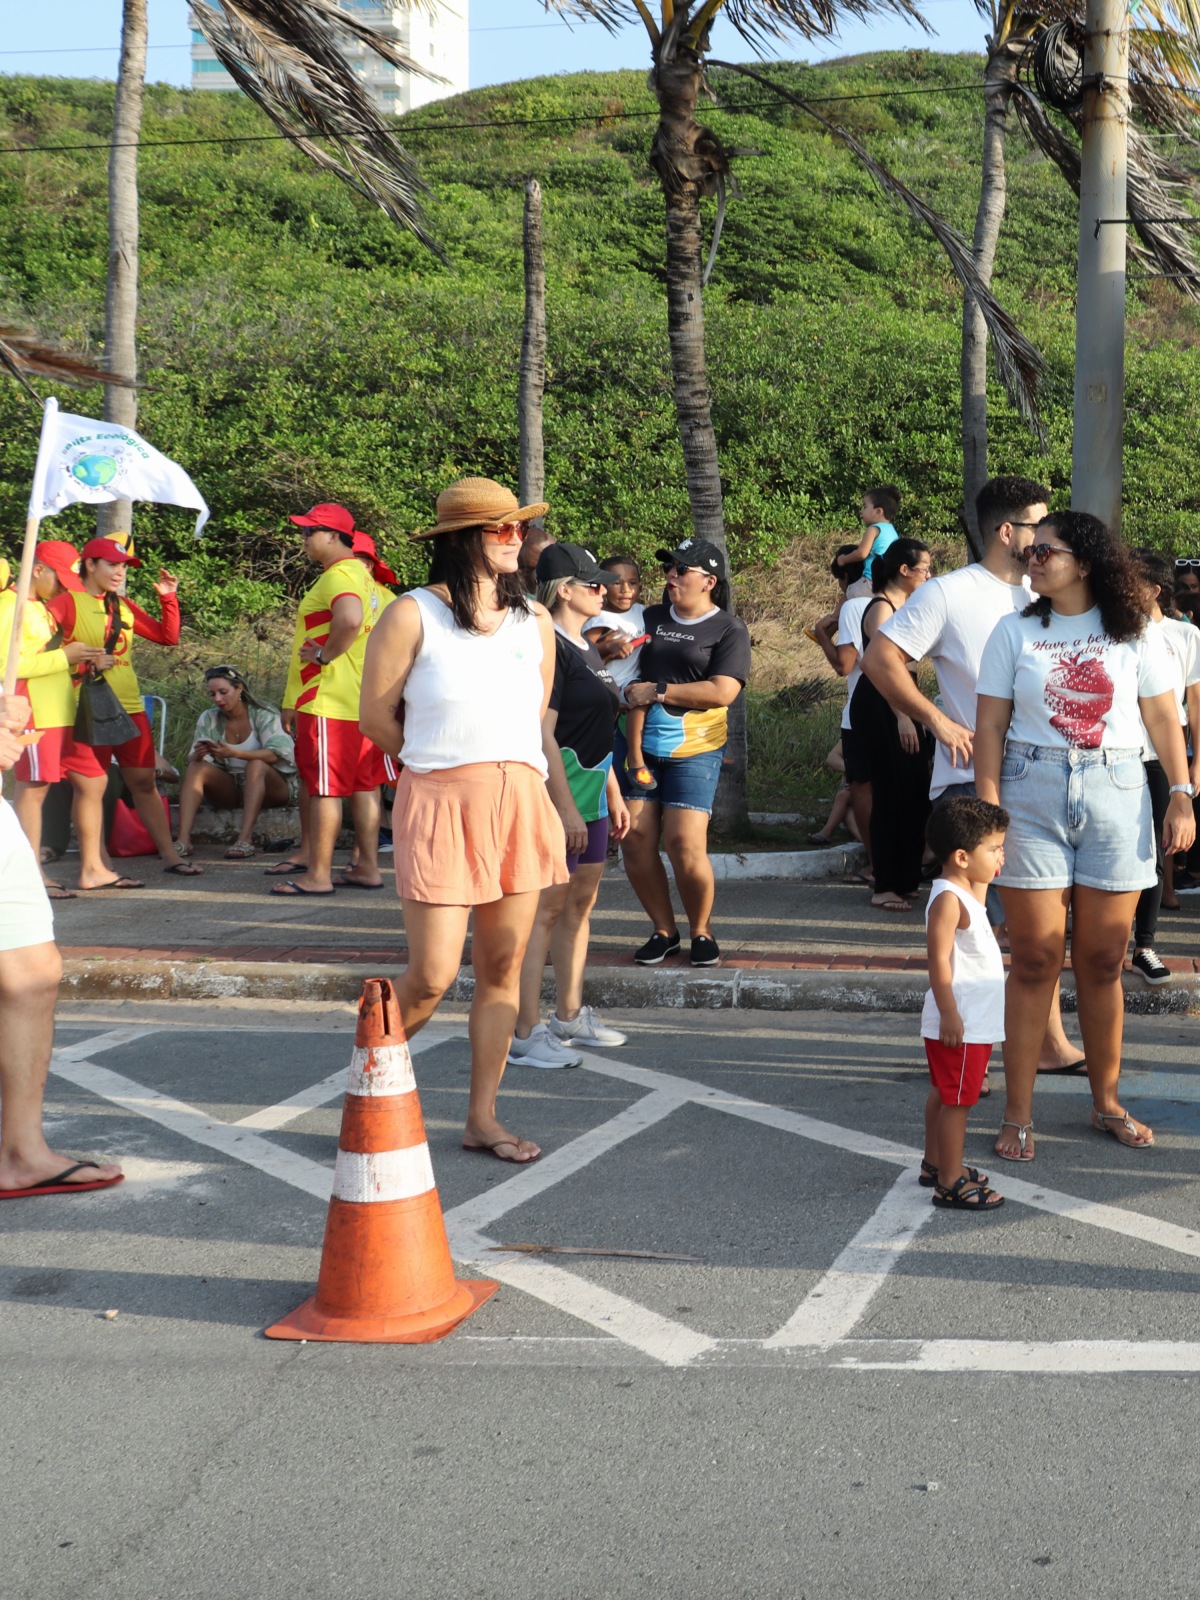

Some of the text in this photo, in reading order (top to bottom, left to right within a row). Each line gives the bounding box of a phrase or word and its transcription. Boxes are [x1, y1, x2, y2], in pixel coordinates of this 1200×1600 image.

[655, 624, 696, 641] Eureca
[1032, 639, 1068, 652] Have
[1073, 639, 1082, 647] a
[1050, 648, 1077, 659] nice
